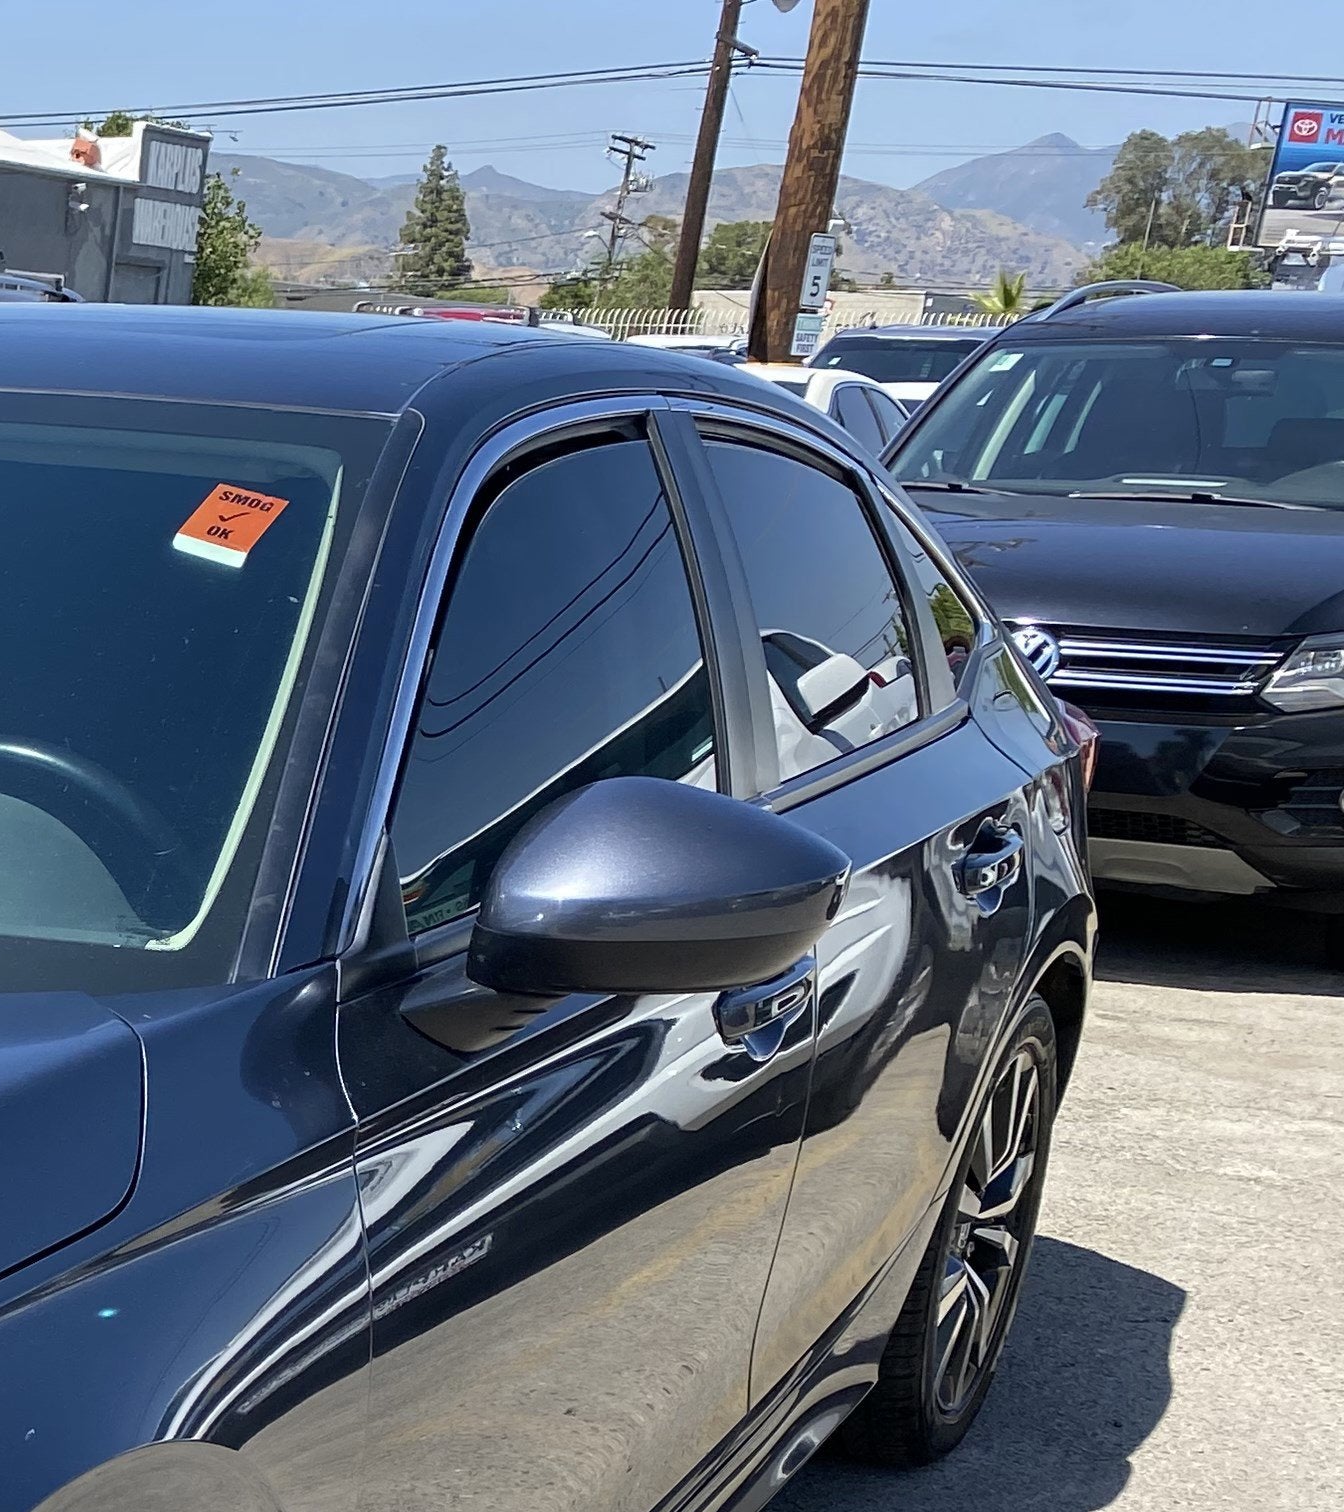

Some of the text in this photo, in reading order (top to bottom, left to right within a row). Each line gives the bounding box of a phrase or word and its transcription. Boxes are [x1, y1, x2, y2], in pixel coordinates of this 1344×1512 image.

[809, 275, 822, 297] 5
[218, 490, 274, 513] SMOG
[206, 525, 234, 541] OK
